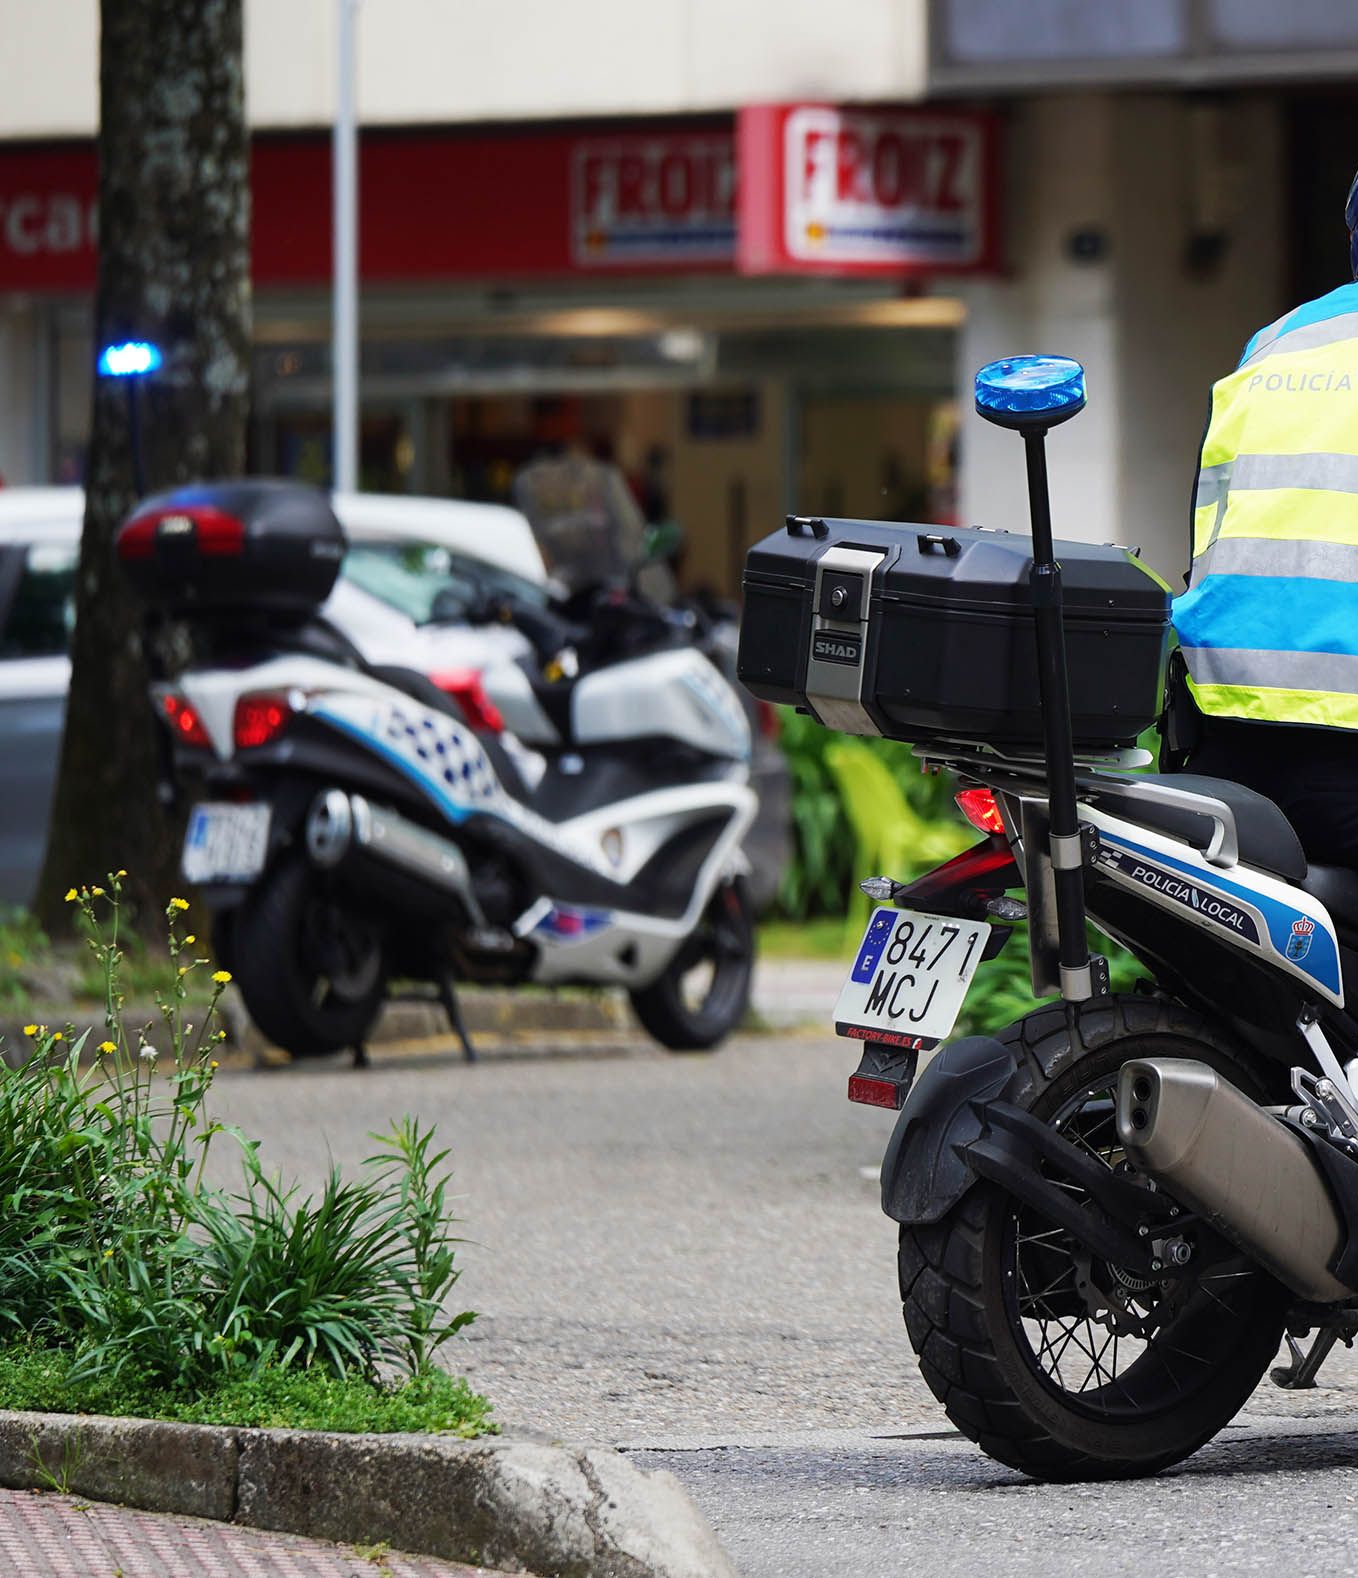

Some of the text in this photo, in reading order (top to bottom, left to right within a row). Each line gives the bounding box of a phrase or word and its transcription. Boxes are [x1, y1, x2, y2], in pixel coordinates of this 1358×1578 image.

[583, 156, 740, 217] FROI
[803, 130, 967, 212] FROIZ
[0, 196, 99, 253] ca
[1248, 370, 1352, 393] POLICÍA
[815, 641, 857, 658] SHAD
[1131, 866, 1244, 930] POLICÍA LOCAL
[861, 955, 874, 971] E
[886, 921, 979, 976] 8471
[864, 969, 939, 1022] MCJ
